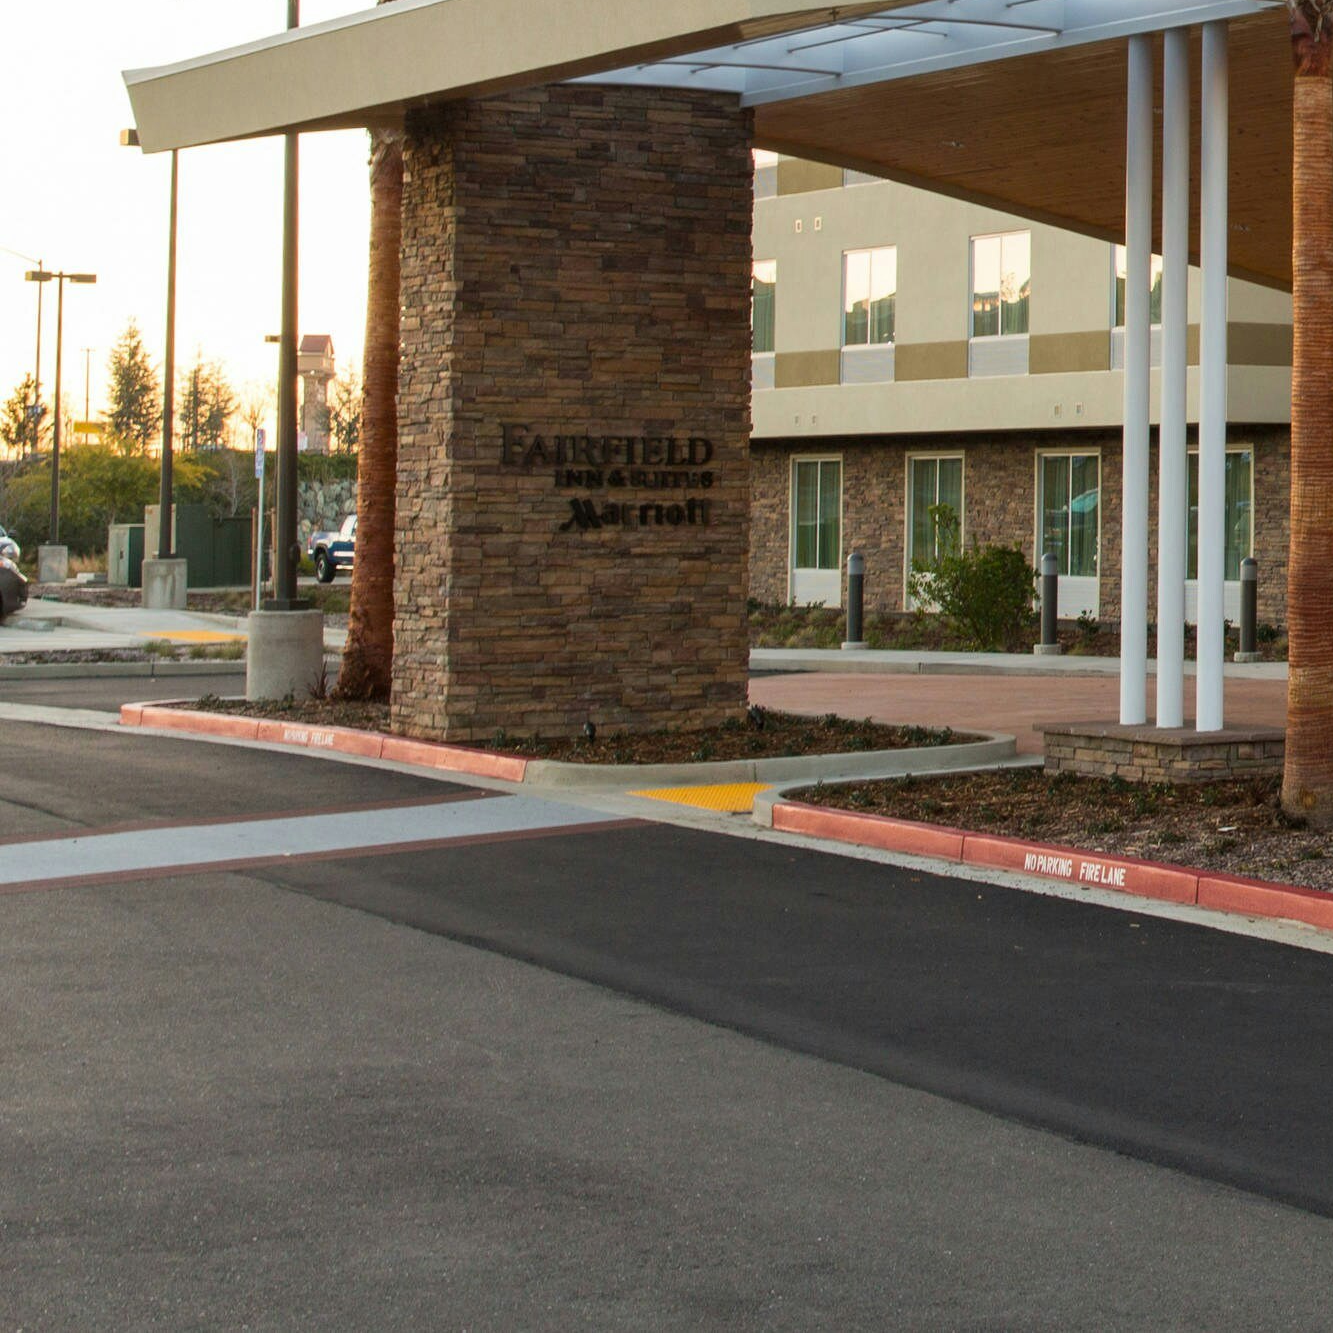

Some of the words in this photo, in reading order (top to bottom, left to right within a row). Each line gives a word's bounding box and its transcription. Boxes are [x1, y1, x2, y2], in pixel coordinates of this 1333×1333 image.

[501, 424, 714, 467] FAIRFIELD
[554, 469, 604, 488] INN
[608, 469, 626, 488] &
[558, 497, 712, 531] Marriott
[1024, 852, 1037, 871] NO
[1037, 854, 1073, 877] PARKING
[1079, 861, 1100, 882] FIRE
[1101, 865, 1126, 886] LANE
